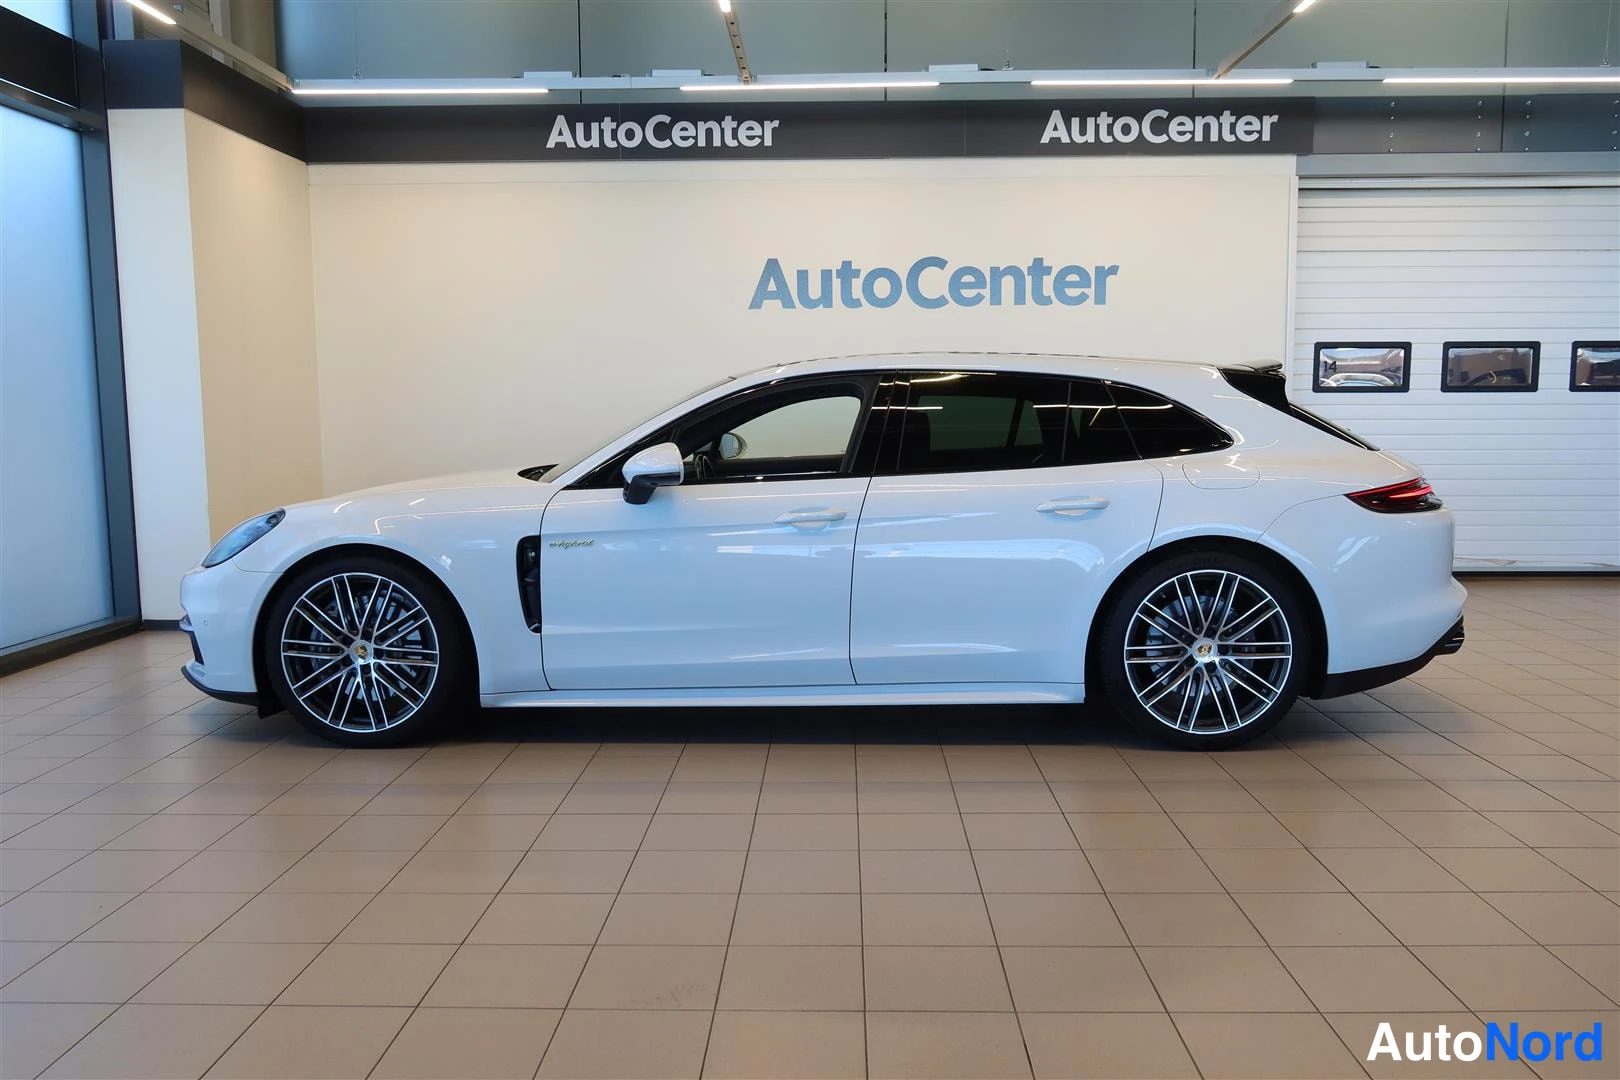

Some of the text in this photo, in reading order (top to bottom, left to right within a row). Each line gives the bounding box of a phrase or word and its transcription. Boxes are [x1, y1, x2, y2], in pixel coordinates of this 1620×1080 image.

[545, 114, 780, 149] AutoCenter
[1039, 109, 1279, 144] AutoCenter
[748, 256, 1119, 310] AutoCenter
[1323, 360, 1338, 373] 14
